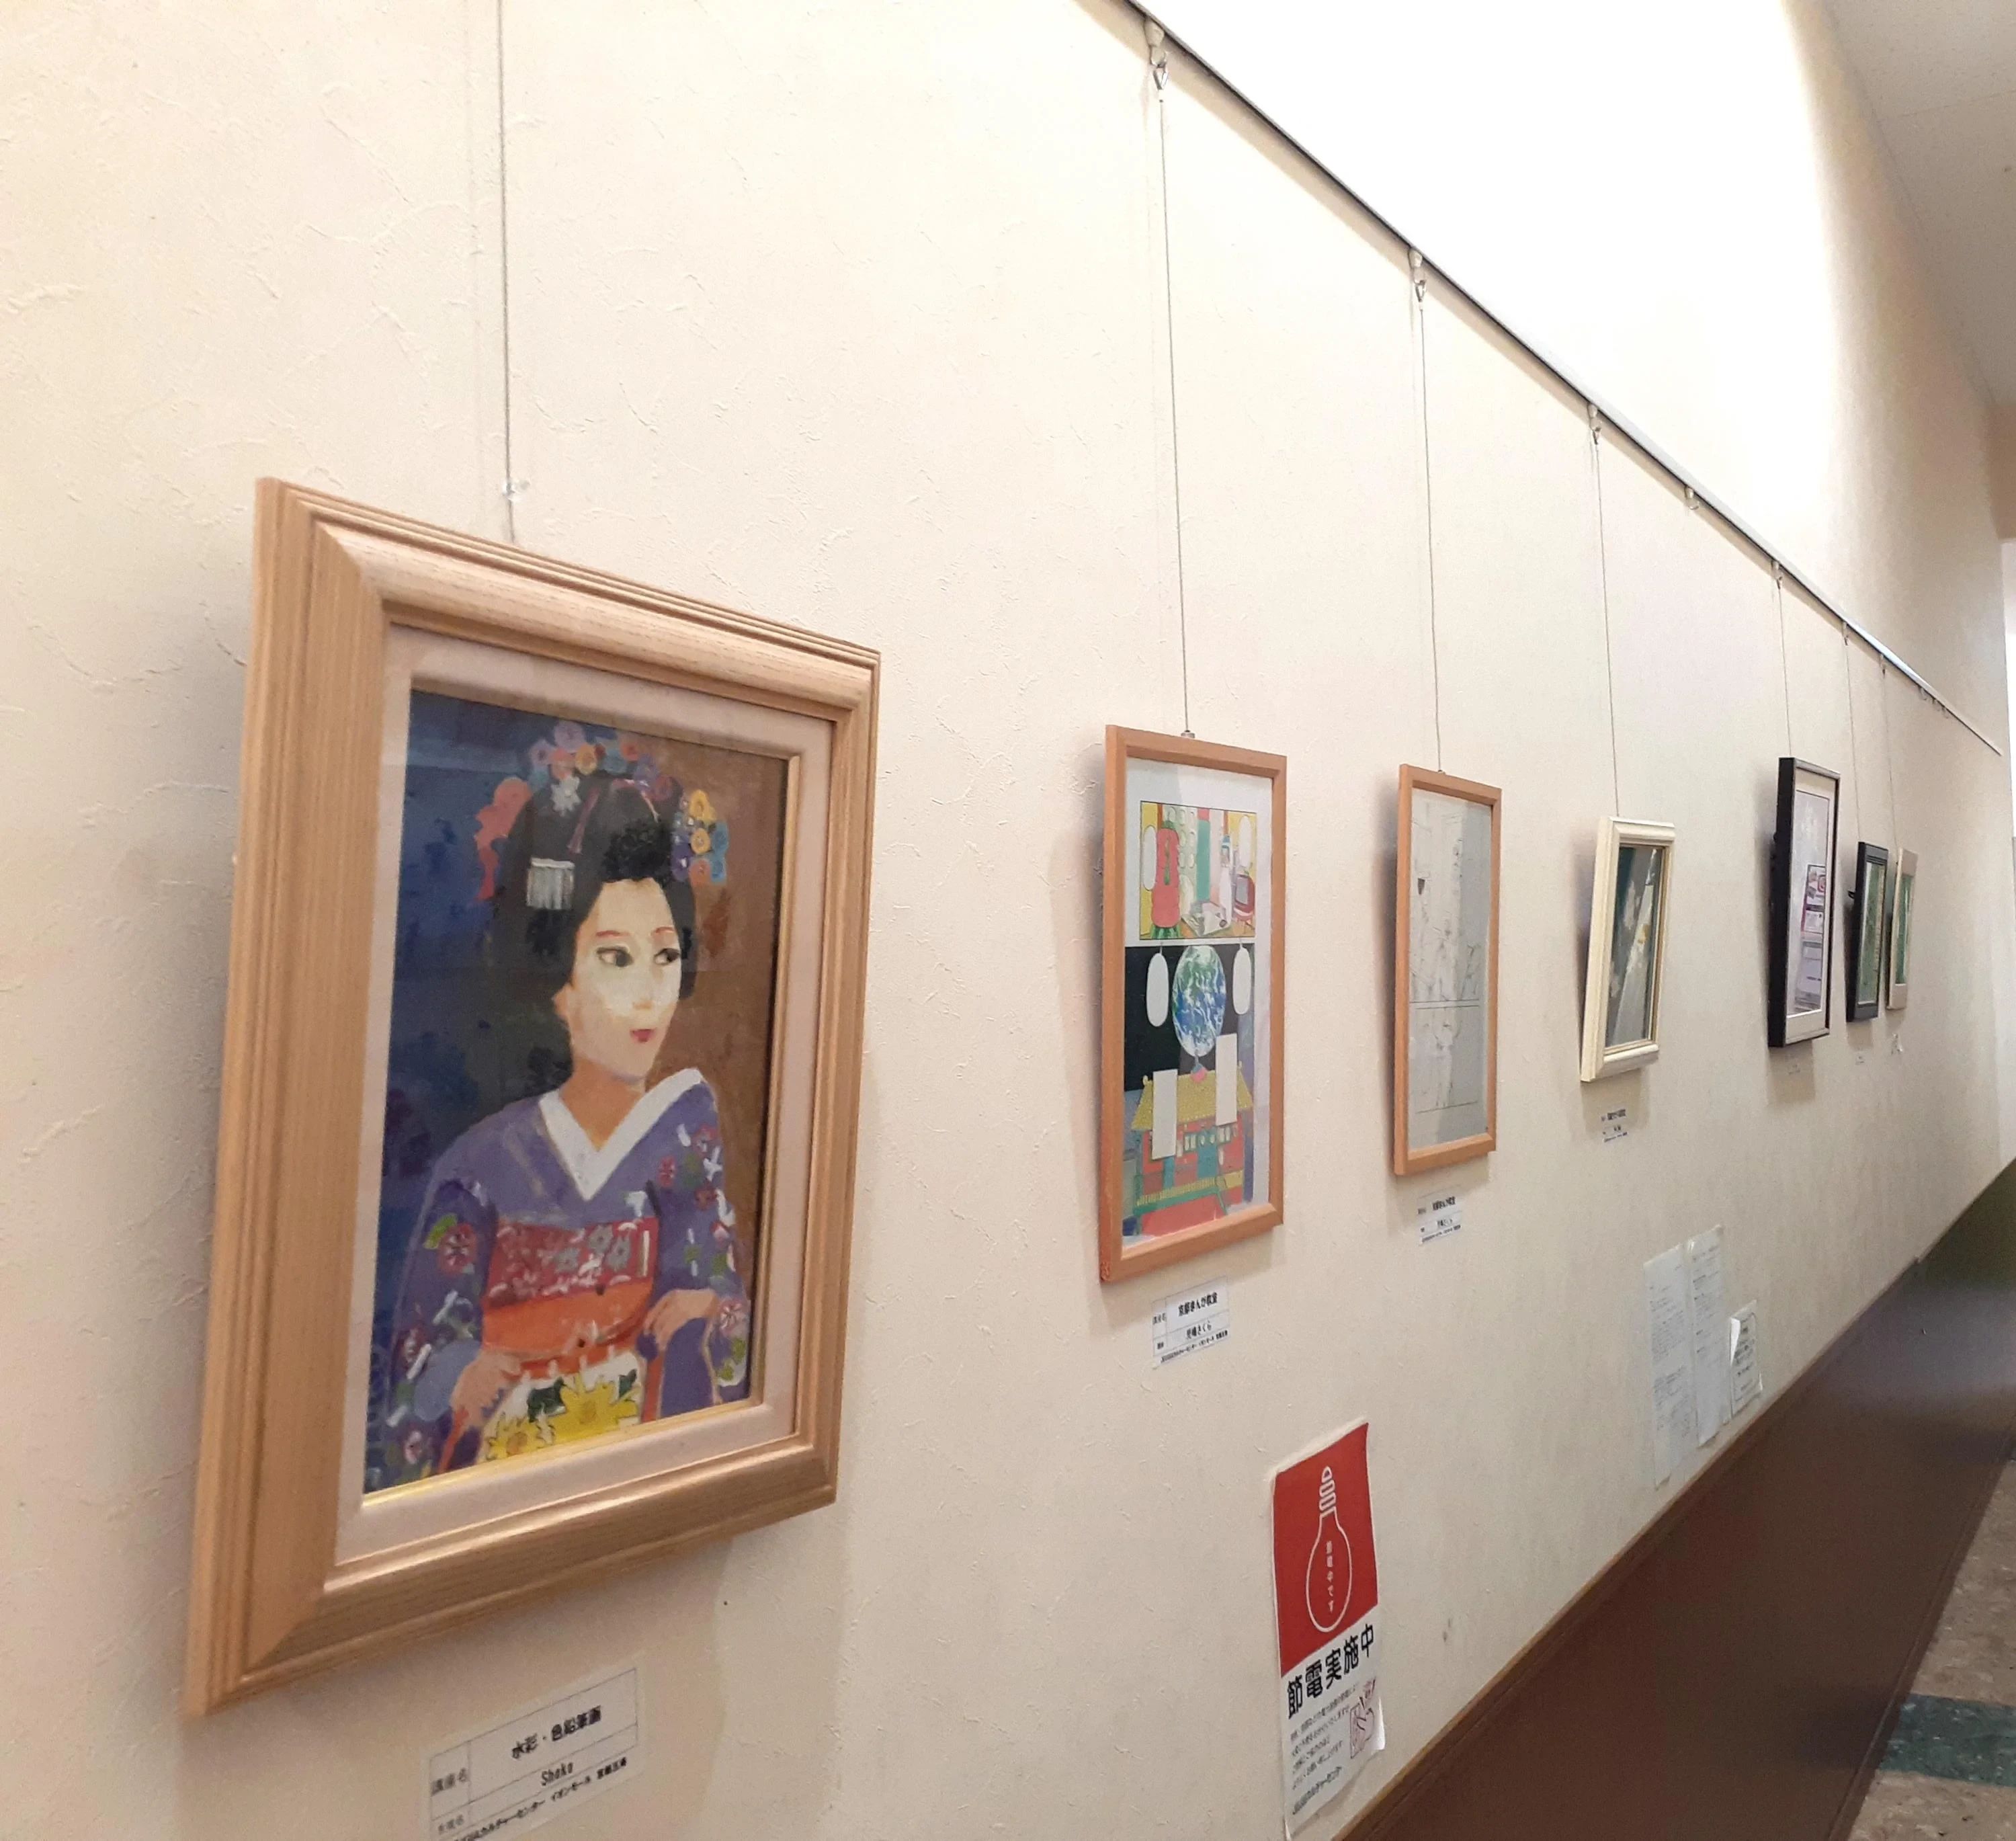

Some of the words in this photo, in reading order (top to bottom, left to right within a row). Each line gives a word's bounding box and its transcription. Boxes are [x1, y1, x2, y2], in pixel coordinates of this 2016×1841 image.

[1288, 1623, 1374, 1719] 節電実施中
